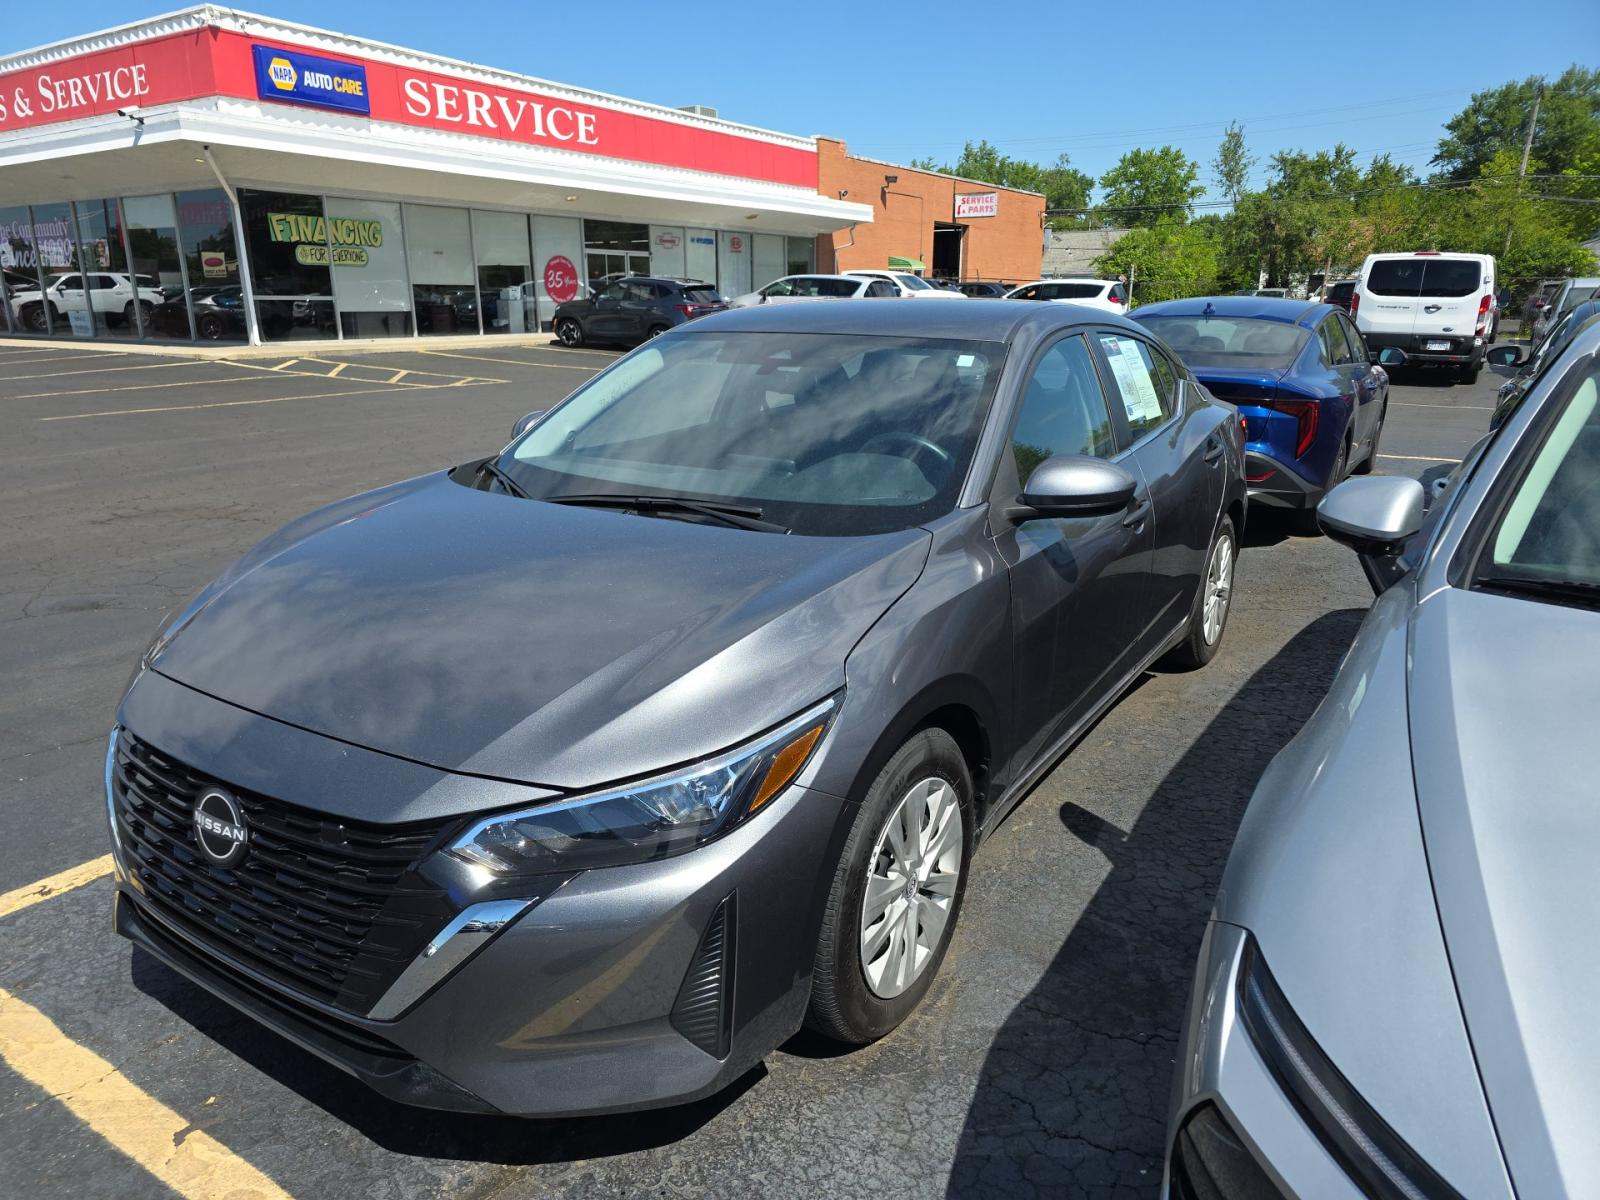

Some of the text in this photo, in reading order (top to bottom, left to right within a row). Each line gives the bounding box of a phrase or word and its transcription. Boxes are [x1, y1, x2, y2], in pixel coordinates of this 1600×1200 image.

[273, 66, 293, 82] NAPA
[14, 87, 34, 118] &
[37, 63, 149, 113] SERVICE
[404, 78, 599, 145] SERVICE
[961, 195, 995, 205] SERVICE
[968, 205, 994, 214] PARTS
[269, 213, 383, 248] FINANCING
[309, 248, 366, 262] FOR EVERYONE
[547, 269, 564, 289] 35
[195, 809, 244, 841] NISSAN
